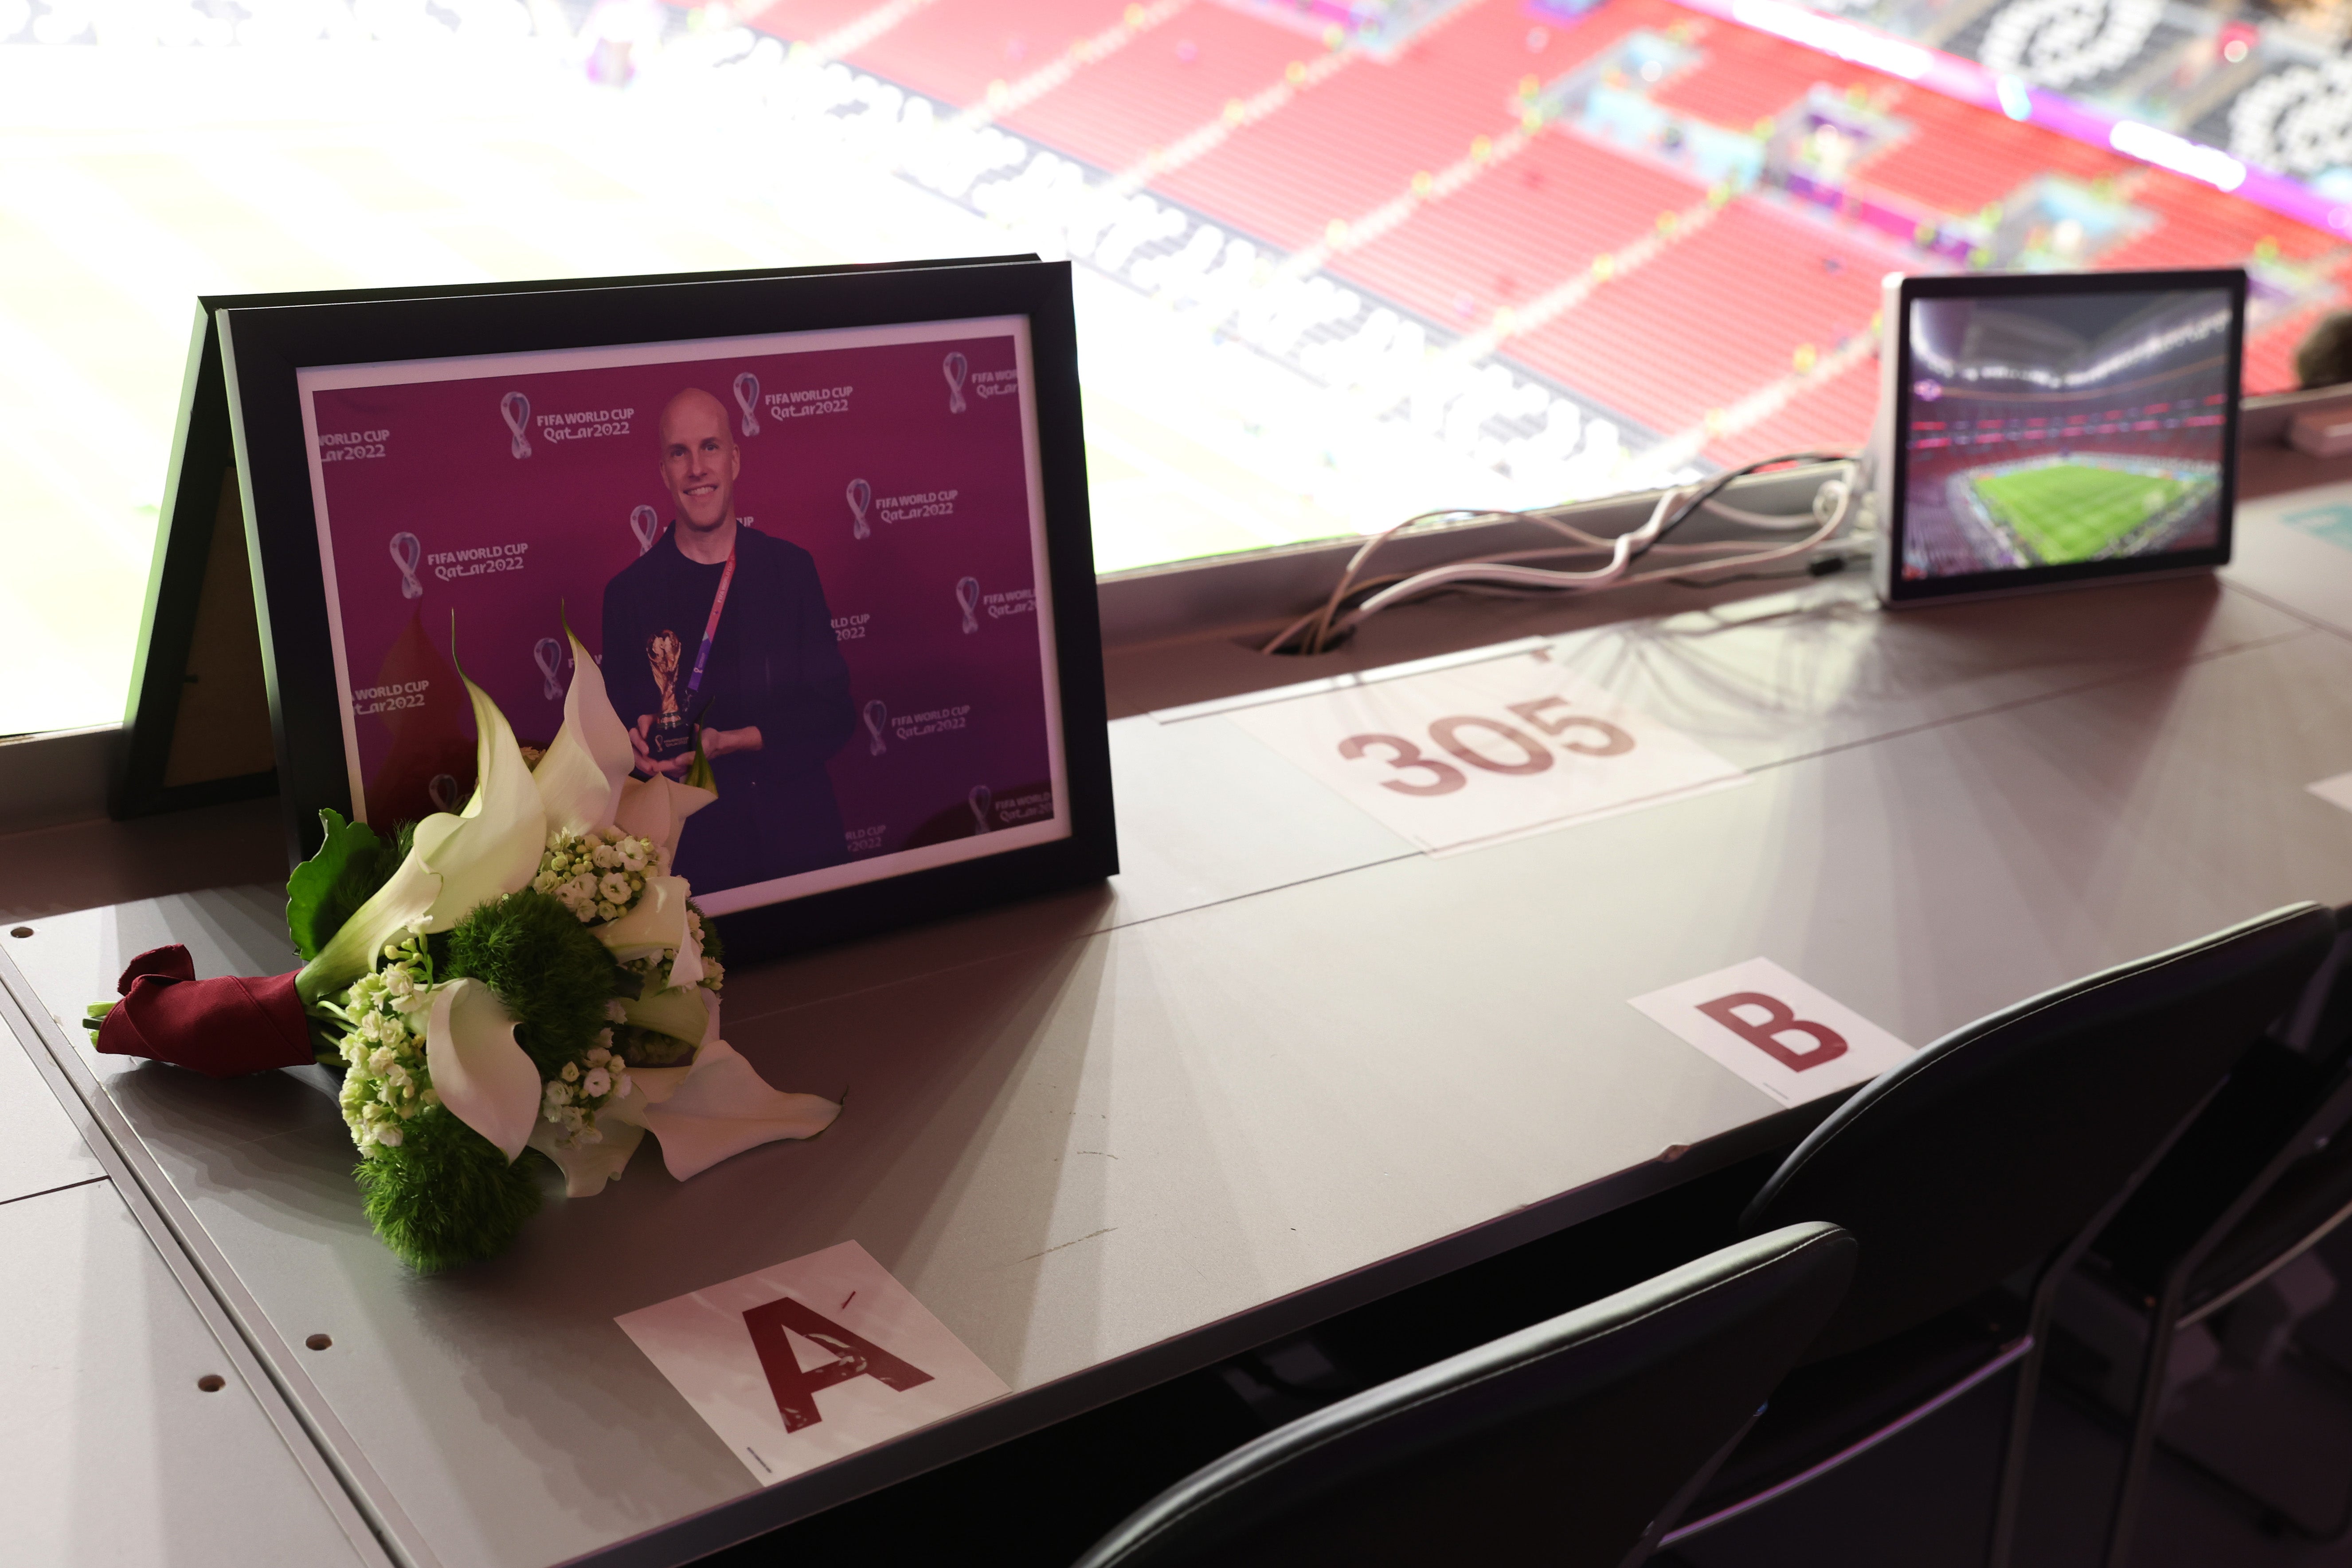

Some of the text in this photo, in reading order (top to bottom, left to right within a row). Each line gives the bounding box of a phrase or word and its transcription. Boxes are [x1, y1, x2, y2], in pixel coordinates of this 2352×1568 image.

[765, 386, 853, 405] FIFA WORLD CUP
[536, 408, 634, 426] FIFA WORLD CUP
[364, 430, 390, 442] CUP
[321, 444, 386, 462] ar2022
[876, 489, 958, 509] FIFA WORLD CUP
[427, 543, 528, 565] FIFA WORLD CUP
[850, 614, 870, 625] CUP
[355, 680, 429, 700] WORLD CUP
[353, 693, 425, 716] tar2022
[892, 705, 971, 727] FIFA WORLD CUP
[1338, 695, 1636, 796] 305
[867, 825, 886, 836] CUP
[1695, 991, 1849, 1073] B
[742, 1297, 935, 1434] A
